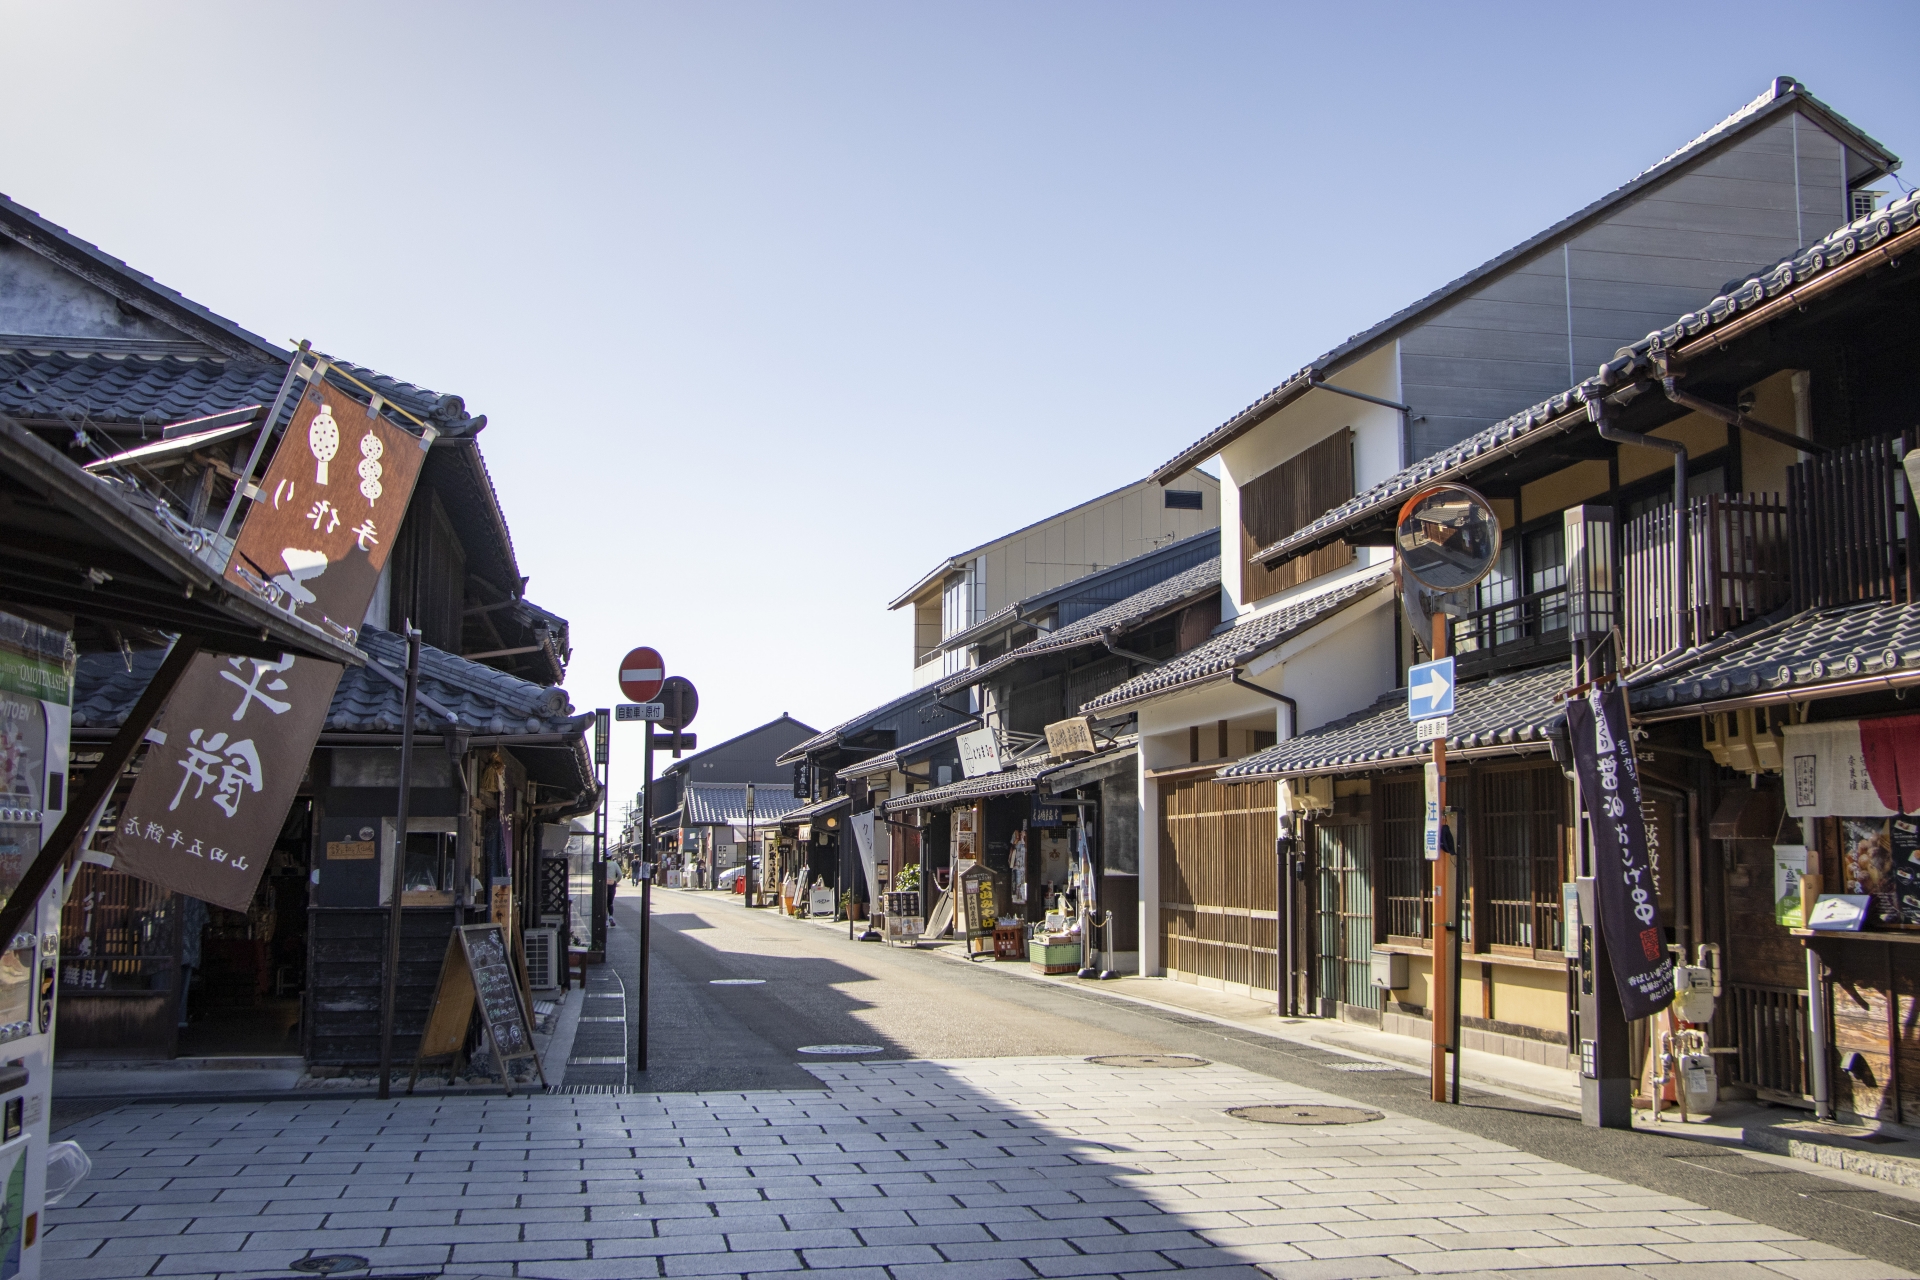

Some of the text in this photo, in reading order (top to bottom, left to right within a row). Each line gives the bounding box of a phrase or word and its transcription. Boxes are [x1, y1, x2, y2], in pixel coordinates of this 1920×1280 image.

[618, 706, 660, 718] 自動車・原付
[1426, 801, 1437, 850] 注意
[1597, 754, 1654, 925] 醤油おこげ串
[979, 881, 995, 927] 犬山みやげ
